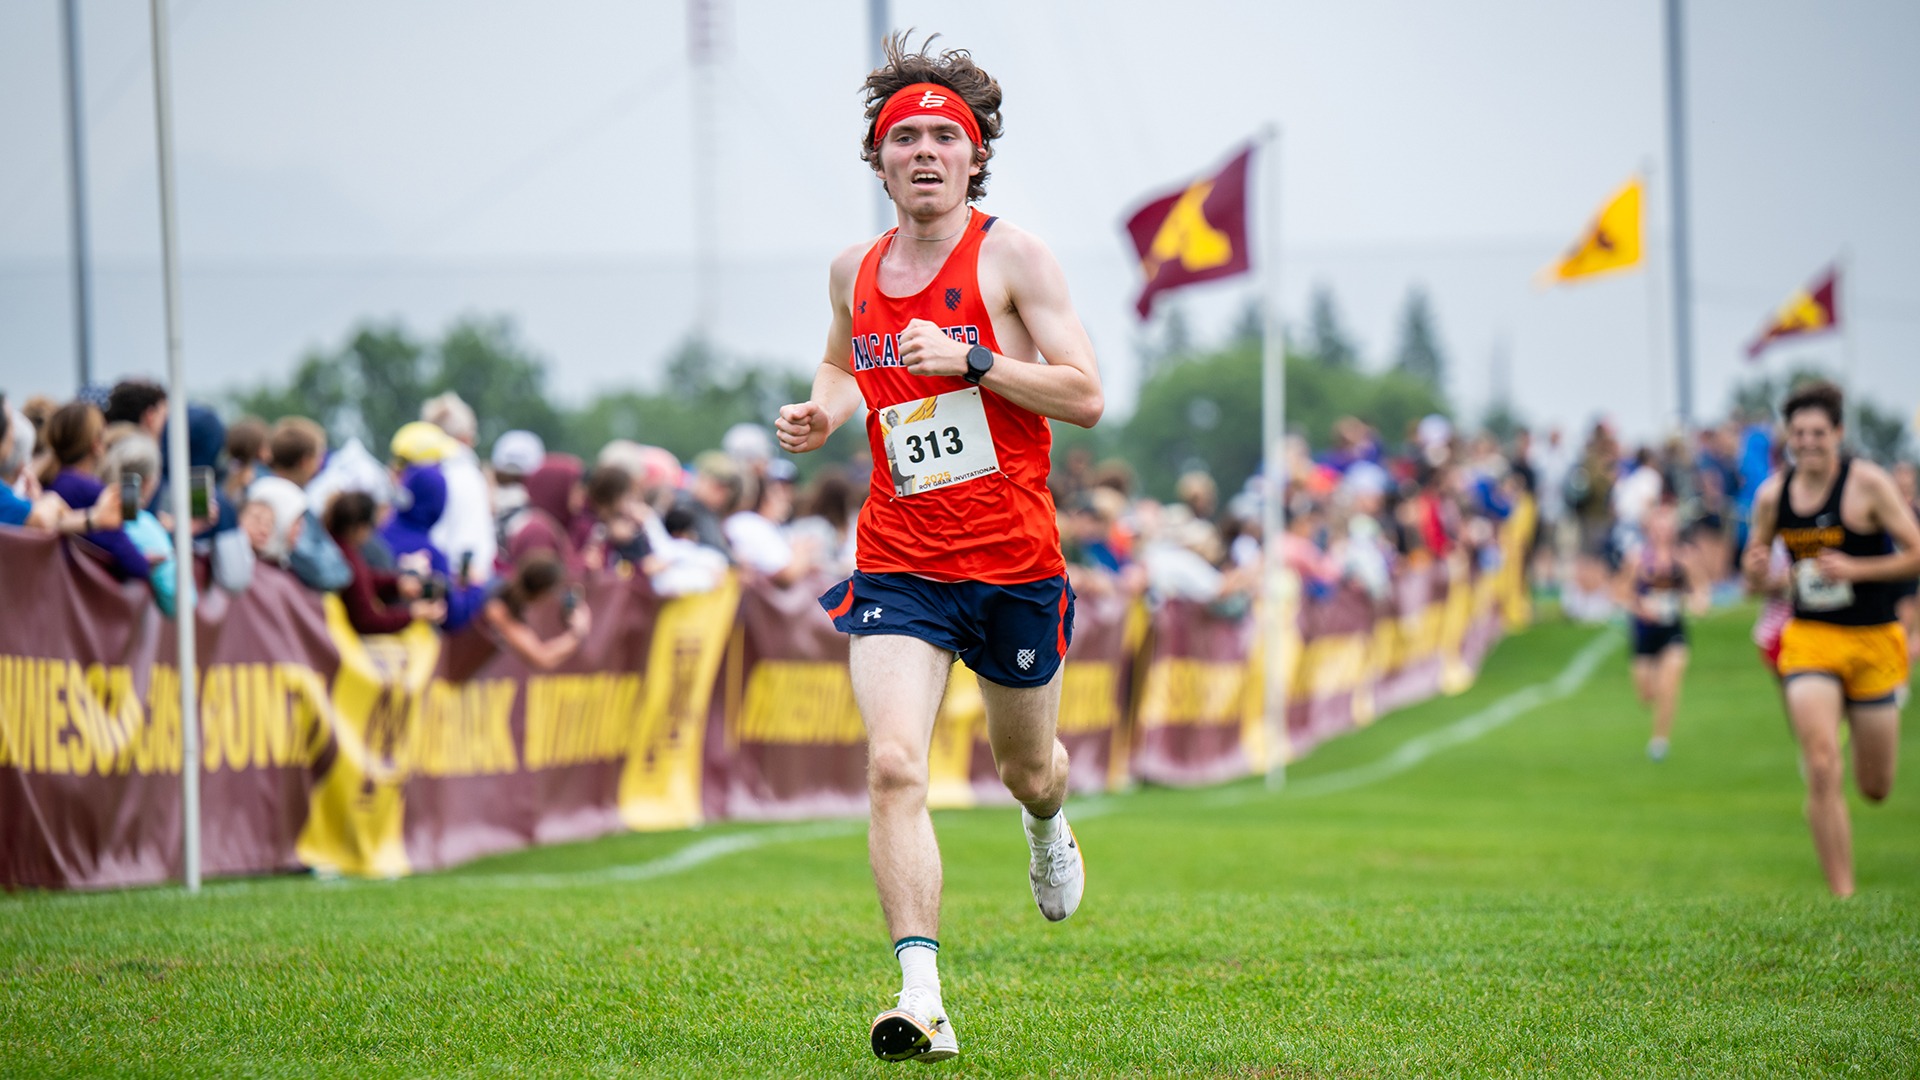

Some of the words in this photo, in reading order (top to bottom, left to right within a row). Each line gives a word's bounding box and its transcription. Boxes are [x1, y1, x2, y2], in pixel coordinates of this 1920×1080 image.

[852, 325, 980, 371] MACAER
[905, 426, 964, 464] 313
[919, 481, 932, 490] ROY
[953, 465, 996, 481] INVITATIONA
[923, 471, 952, 485] 2025
